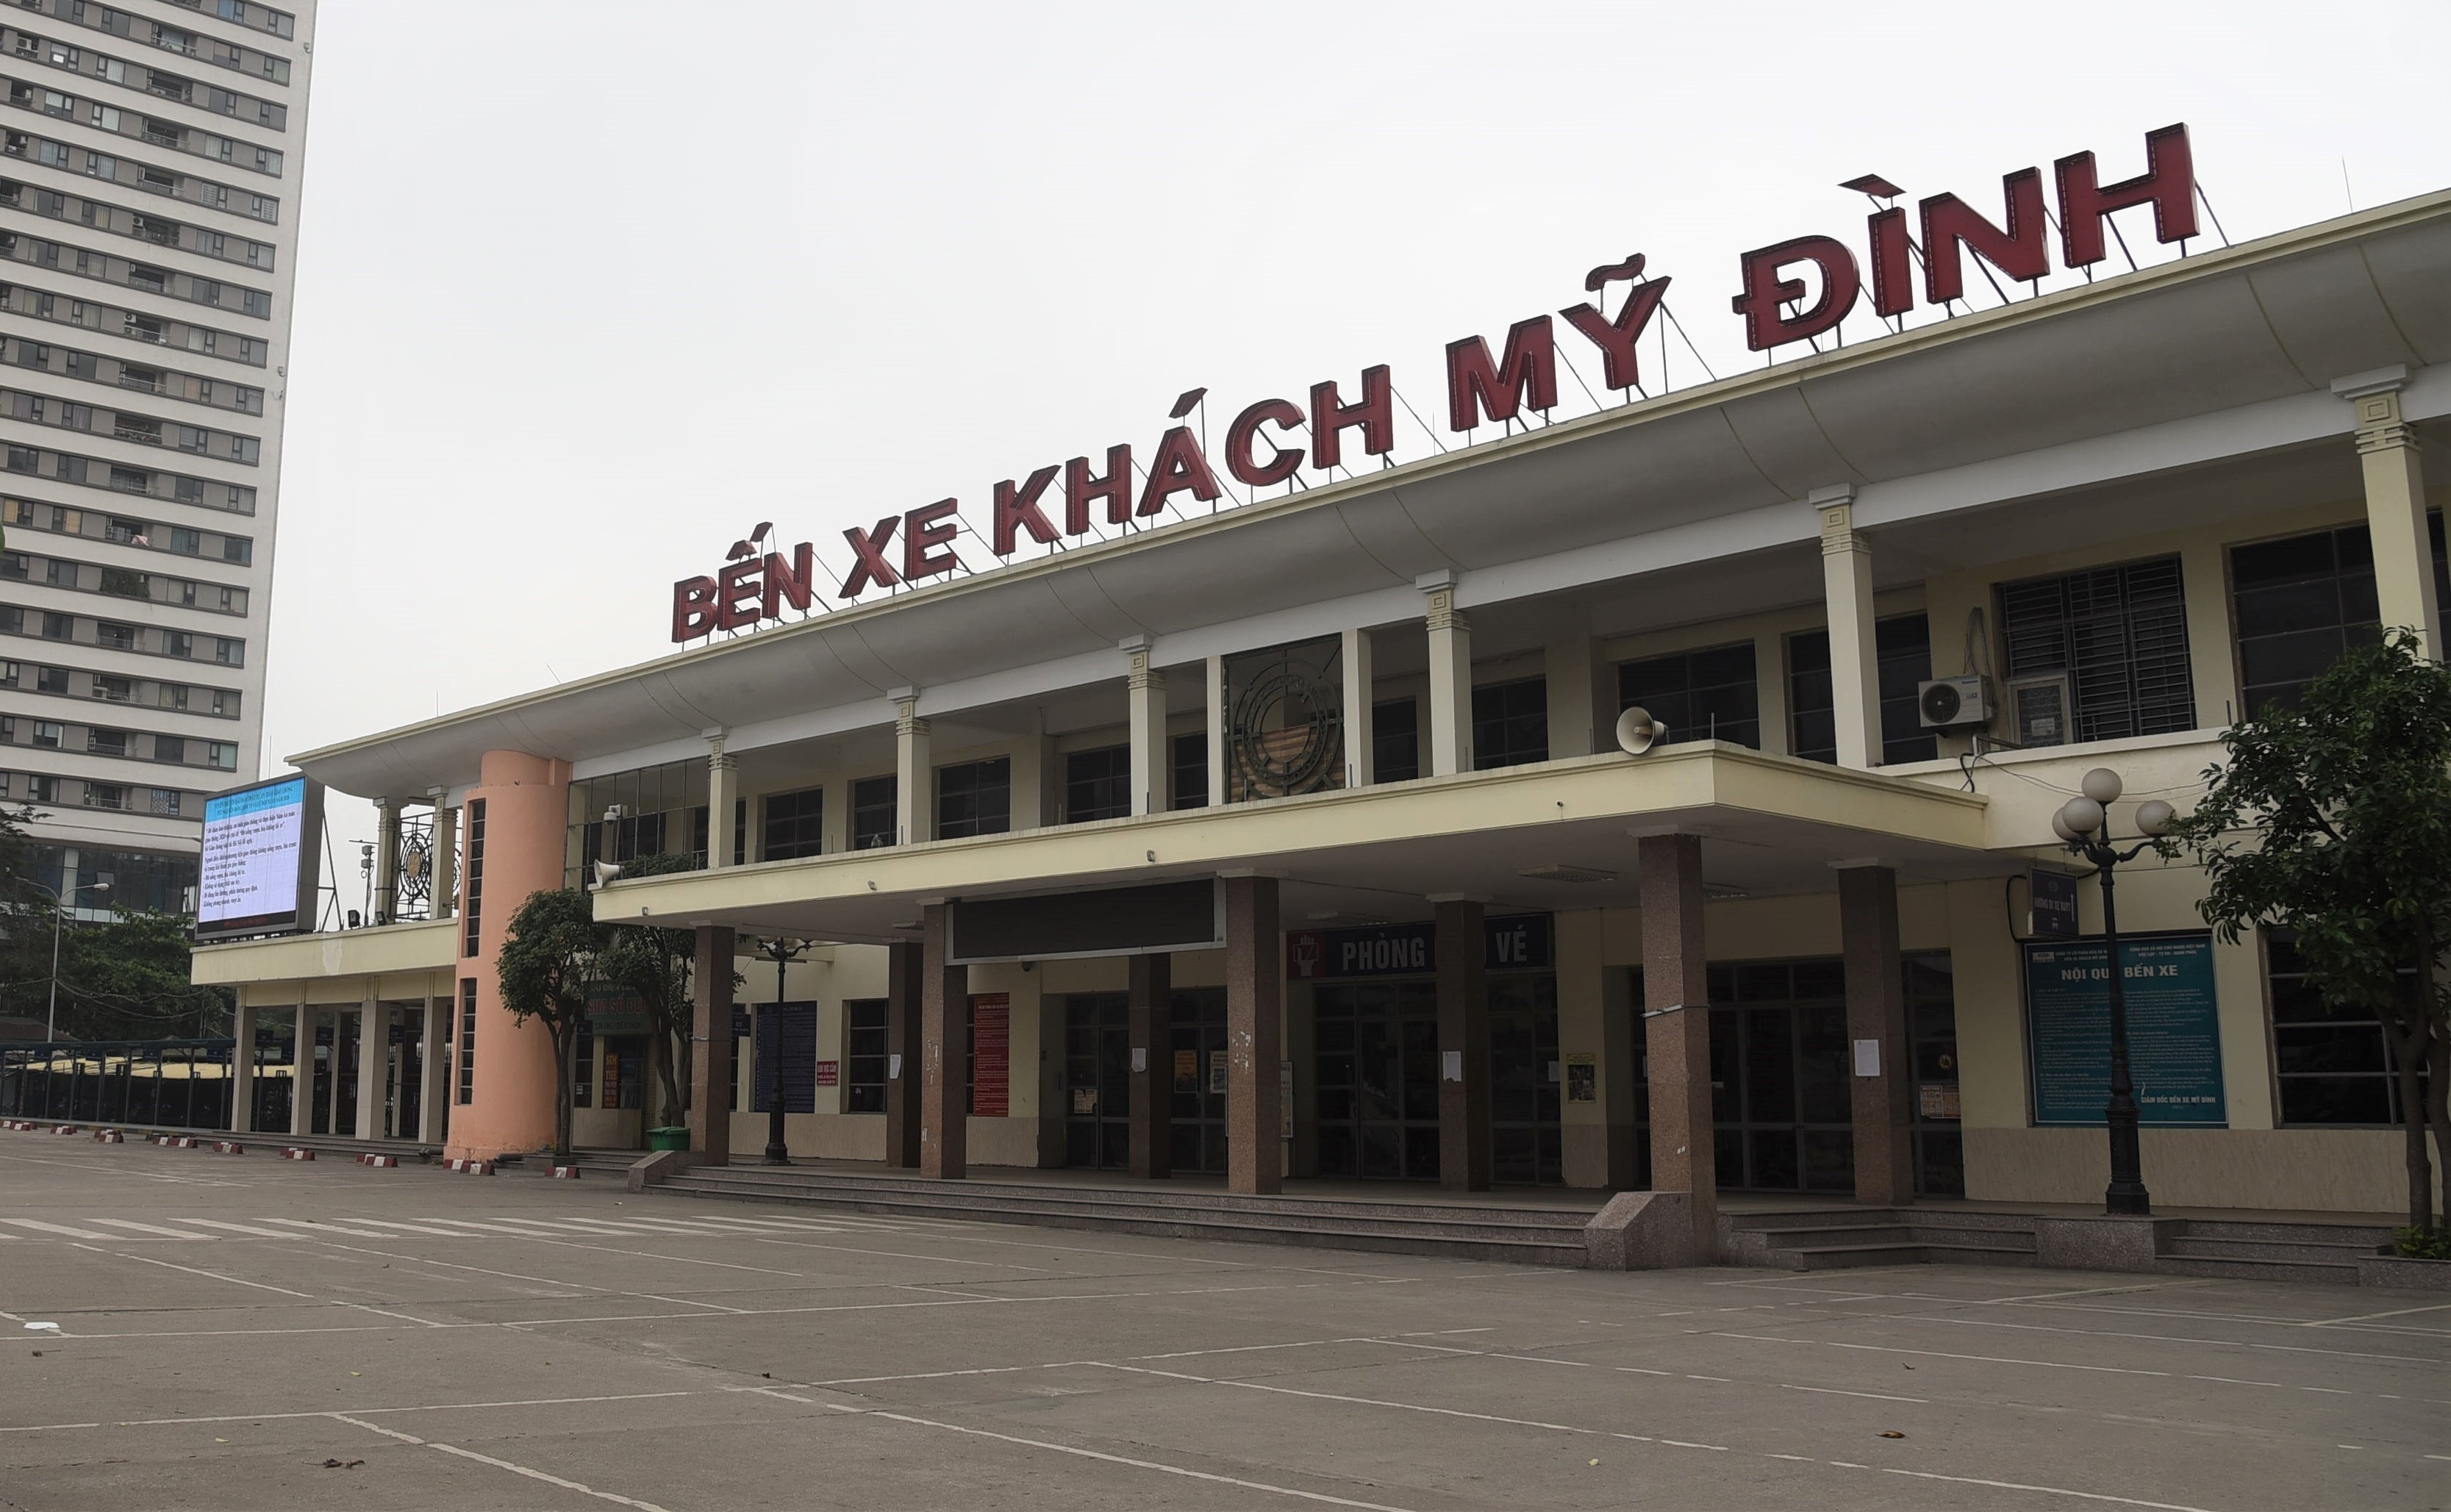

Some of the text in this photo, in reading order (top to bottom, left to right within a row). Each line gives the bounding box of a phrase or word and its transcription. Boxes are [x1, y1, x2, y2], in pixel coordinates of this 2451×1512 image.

[672, 122, 2200, 643] BẾN XE KHÁCH MỸ ĐÌNH
[1342, 932, 1425, 971] PHÒNG
[1495, 923, 1528, 963] VÉ
[2061, 963, 2178, 982] NỘI QU BẾN XE
